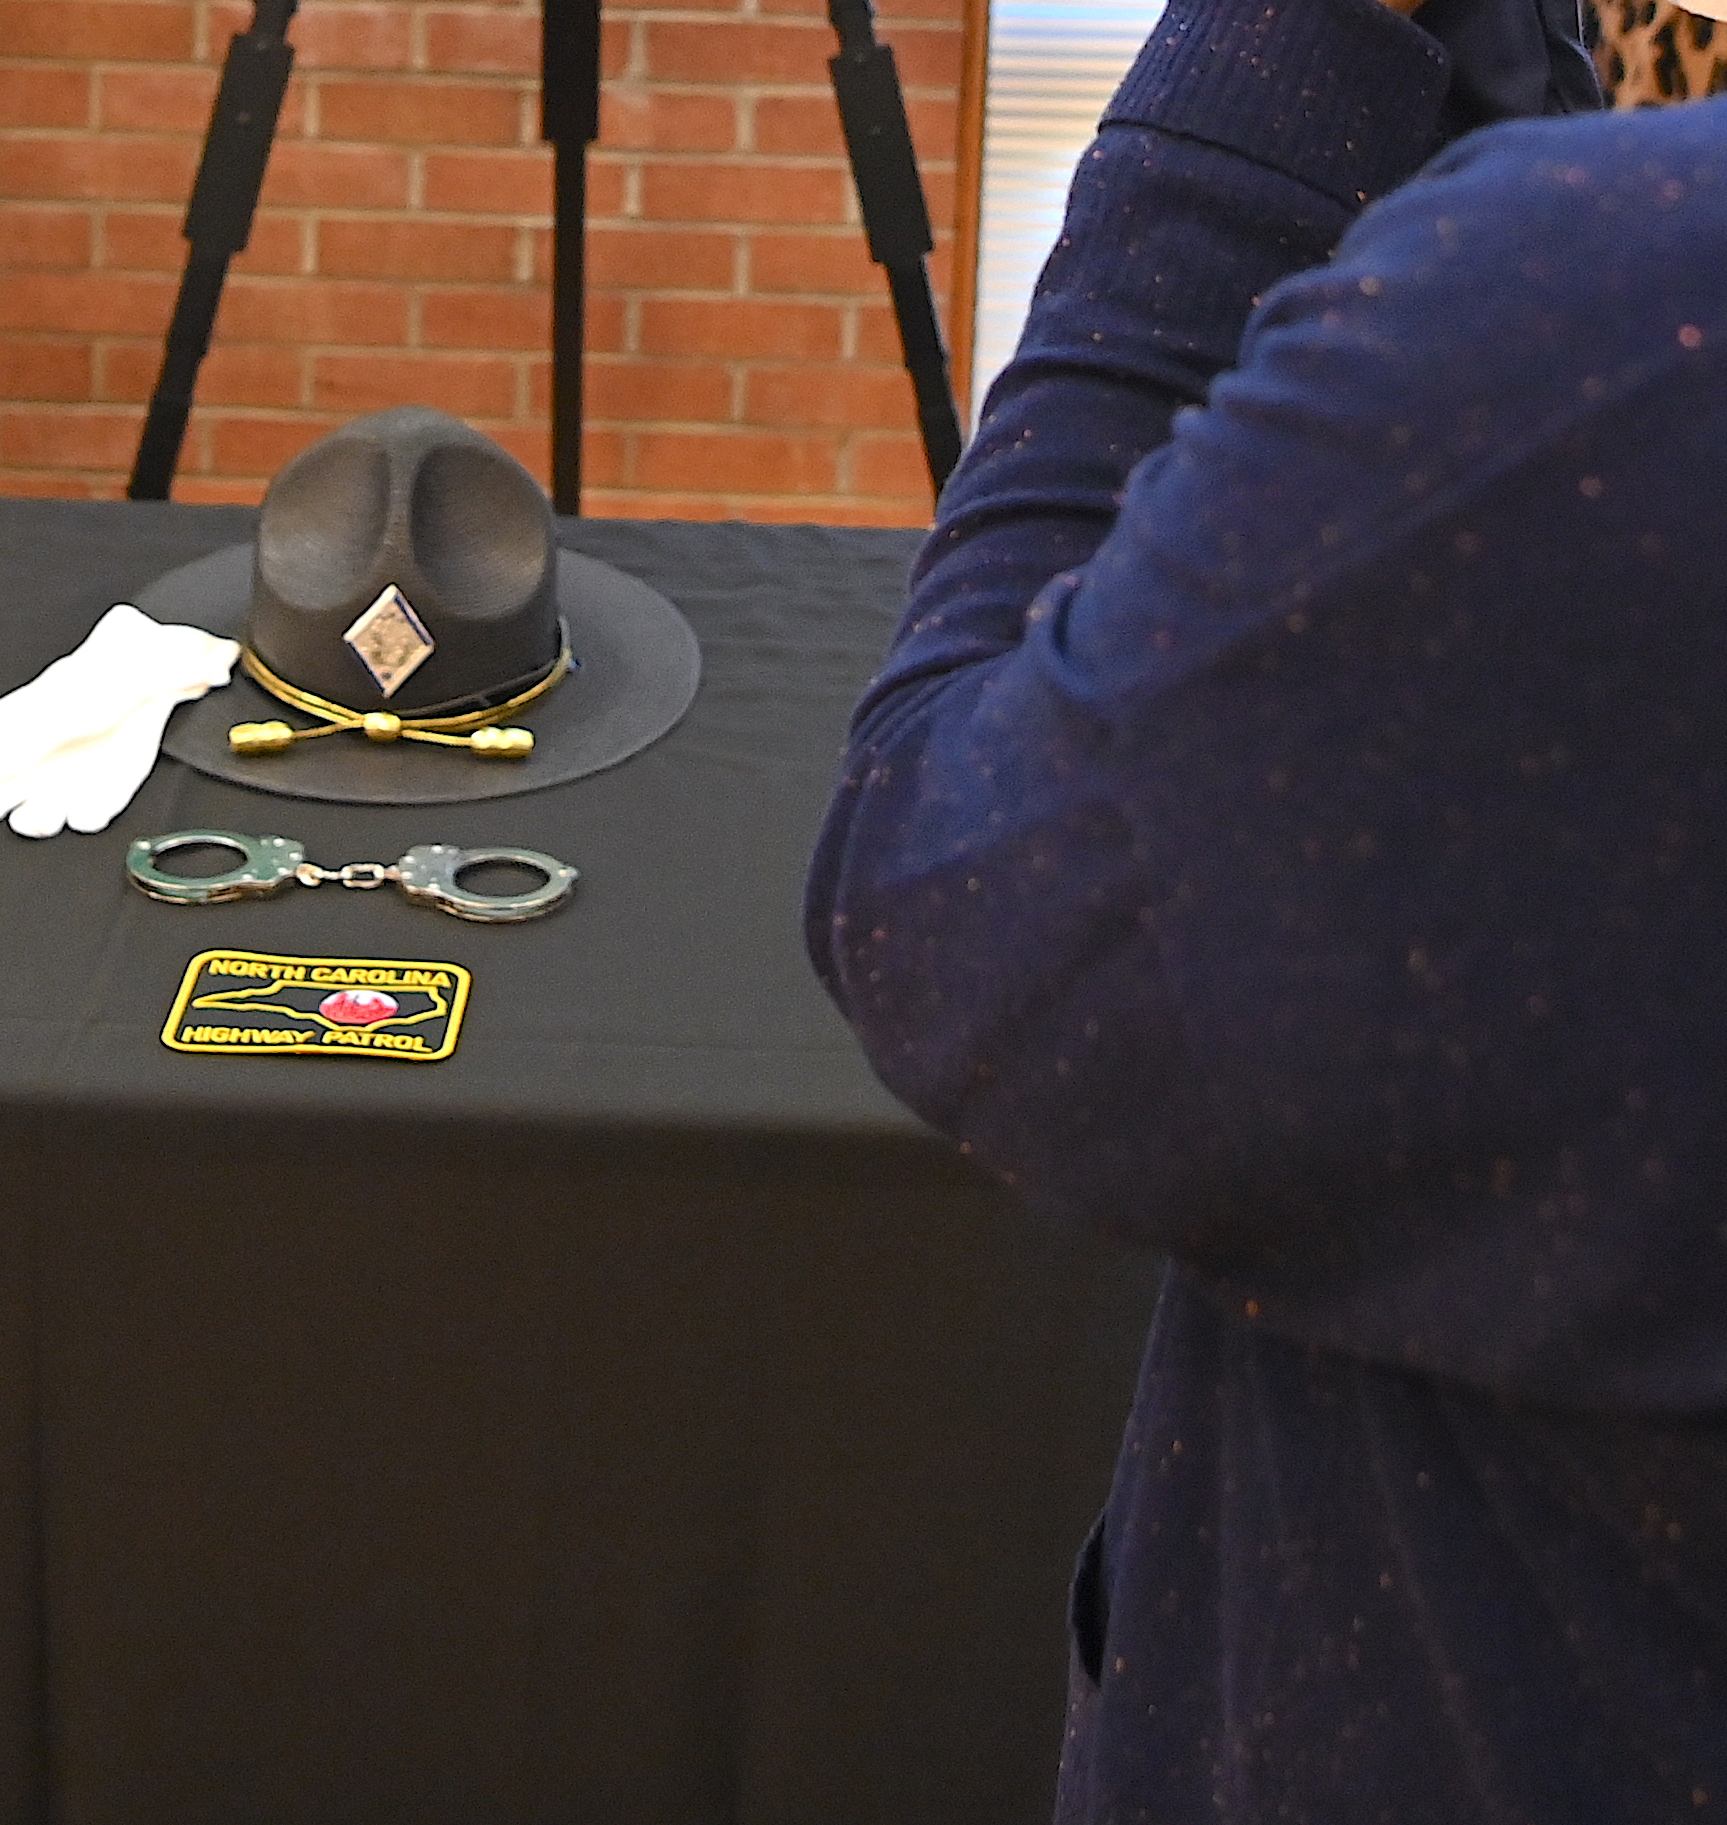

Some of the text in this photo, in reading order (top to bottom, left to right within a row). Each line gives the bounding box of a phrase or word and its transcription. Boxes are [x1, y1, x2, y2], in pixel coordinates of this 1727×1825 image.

[208, 959, 452, 989] NORTH CAROLINA
[181, 1026, 433, 1053] HIGHWAY PATROL
